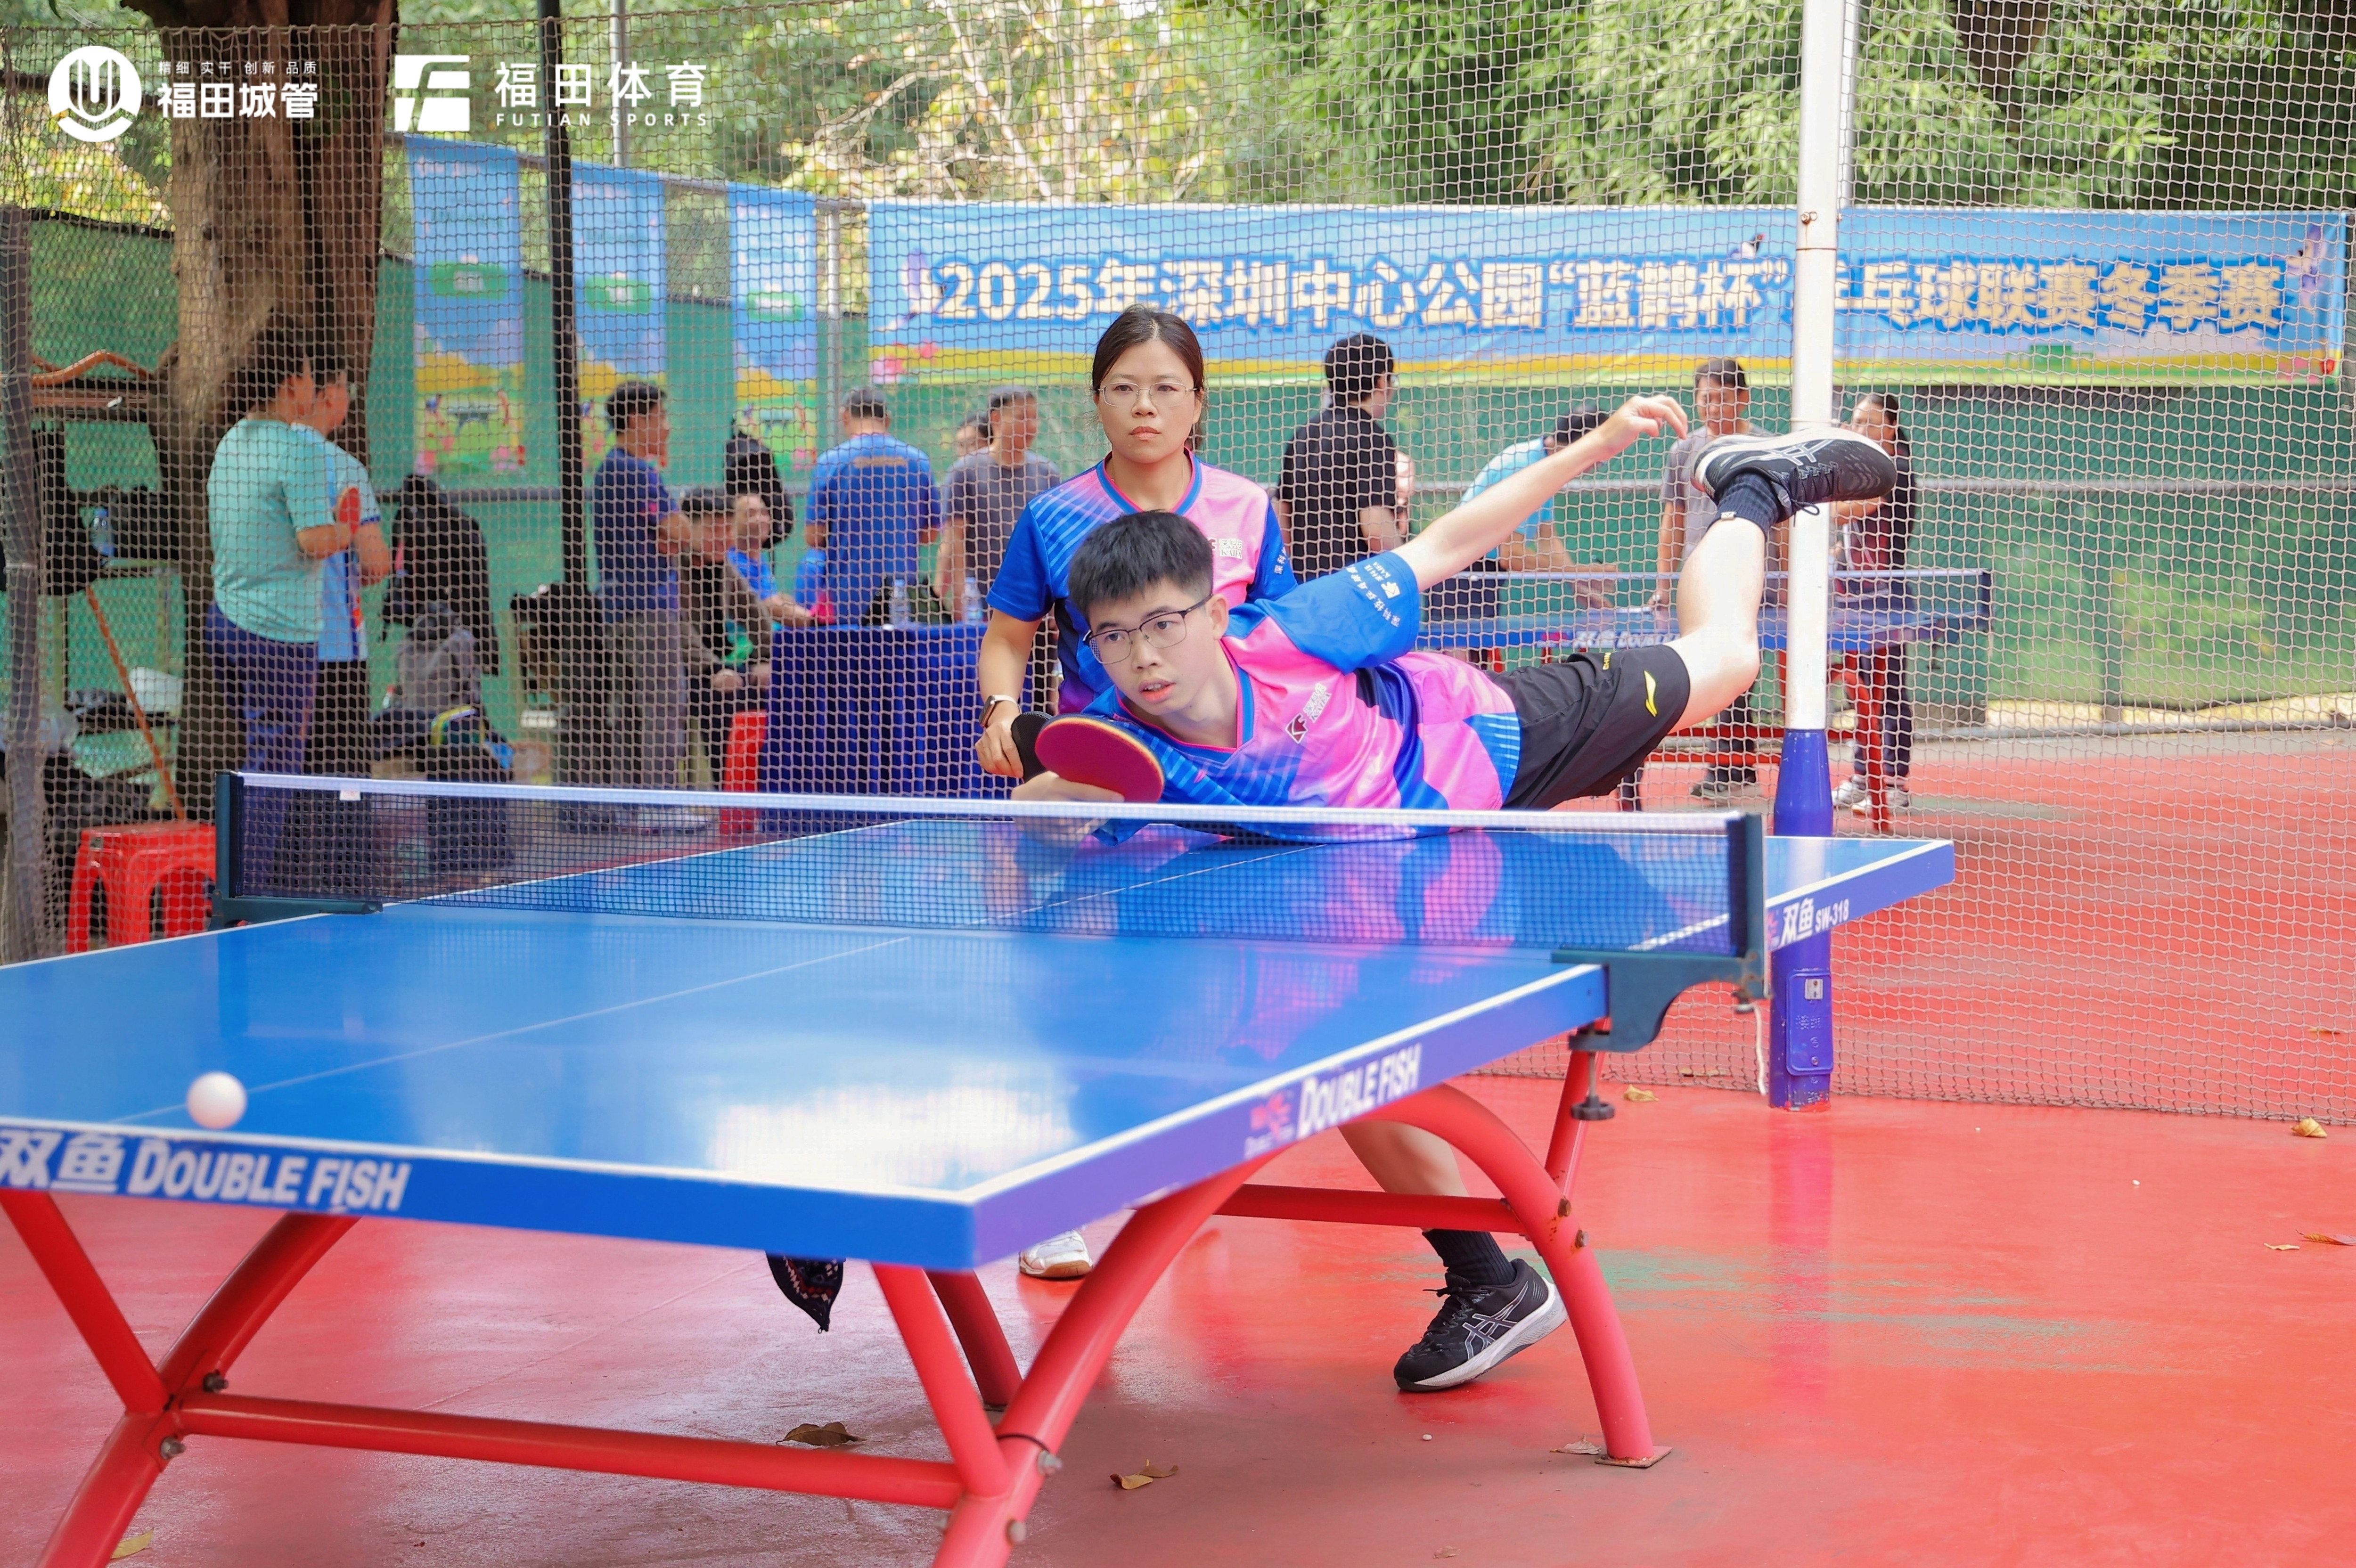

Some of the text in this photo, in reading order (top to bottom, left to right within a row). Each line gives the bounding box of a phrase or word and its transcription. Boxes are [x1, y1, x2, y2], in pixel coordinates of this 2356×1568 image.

[1220, 549, 1243, 559] KAIFA
[1309, 692, 1331, 723] KAIFA
[1780, 898, 1850, 947] 双鱼 SW-318
[1297, 1043, 1422, 1139] DOUBLE FISH
[0, 1129, 412, 1213] 双鱼 DOUBLE FISH
